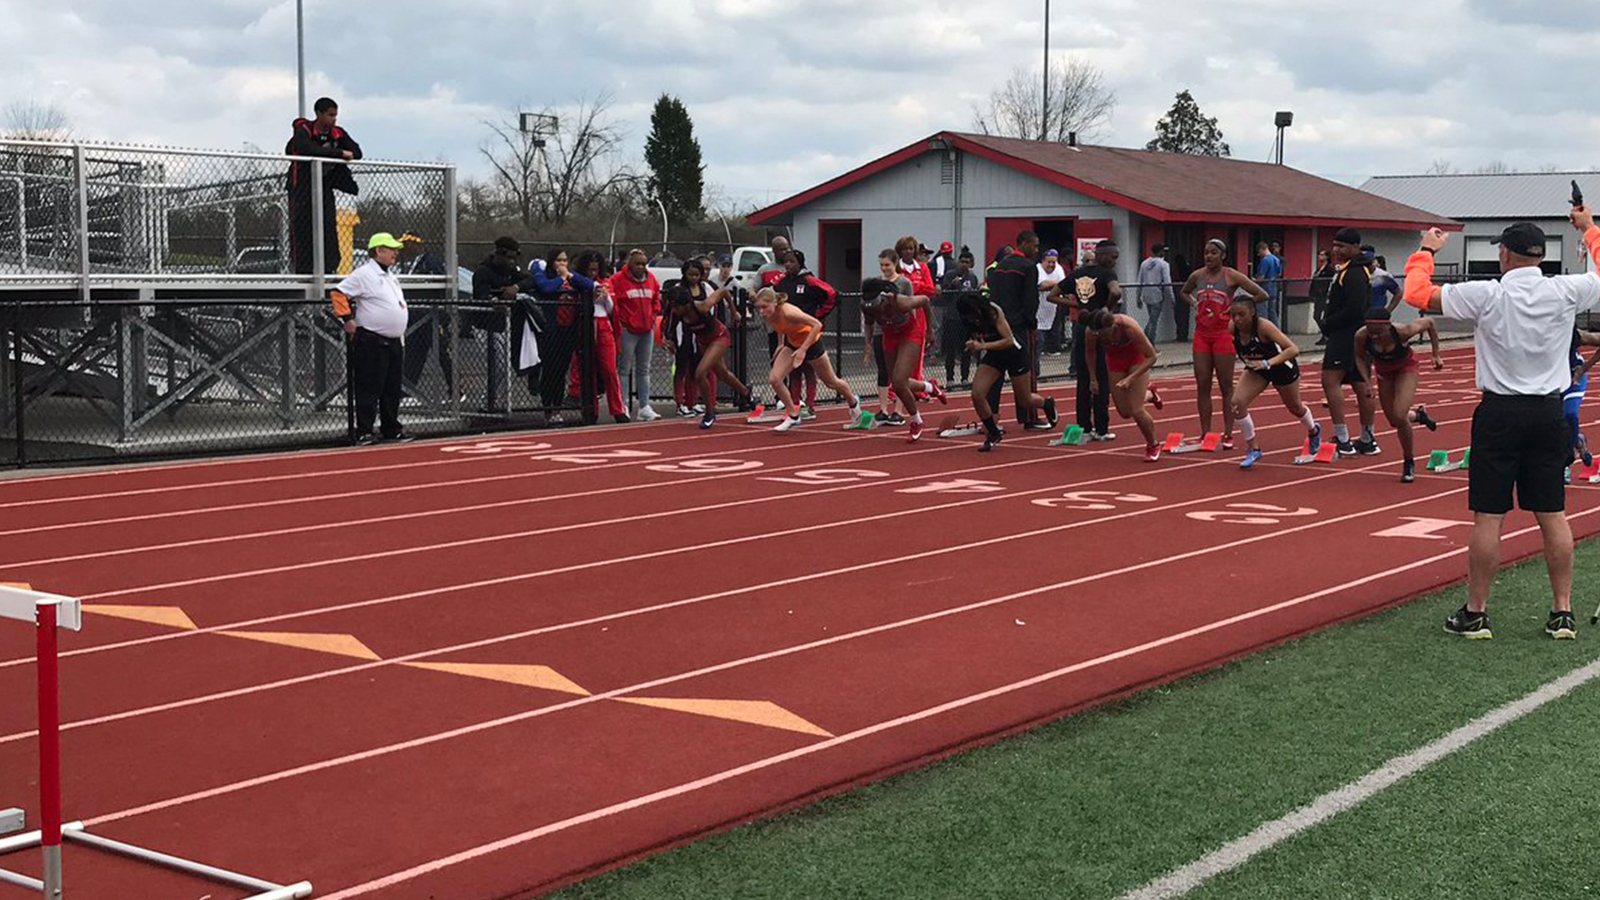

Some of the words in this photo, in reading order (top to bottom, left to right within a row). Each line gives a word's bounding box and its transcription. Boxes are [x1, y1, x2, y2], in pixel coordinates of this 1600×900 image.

[440, 441, 552, 453] 8
[530, 449, 662, 463] 7
[645, 459, 764, 472] 6
[756, 468, 890, 484] 5
[894, 479, 1007, 493] 4
[1031, 491, 1158, 510] 3
[1186, 503, 1319, 525] 2
[1369, 516, 1475, 539] 1
